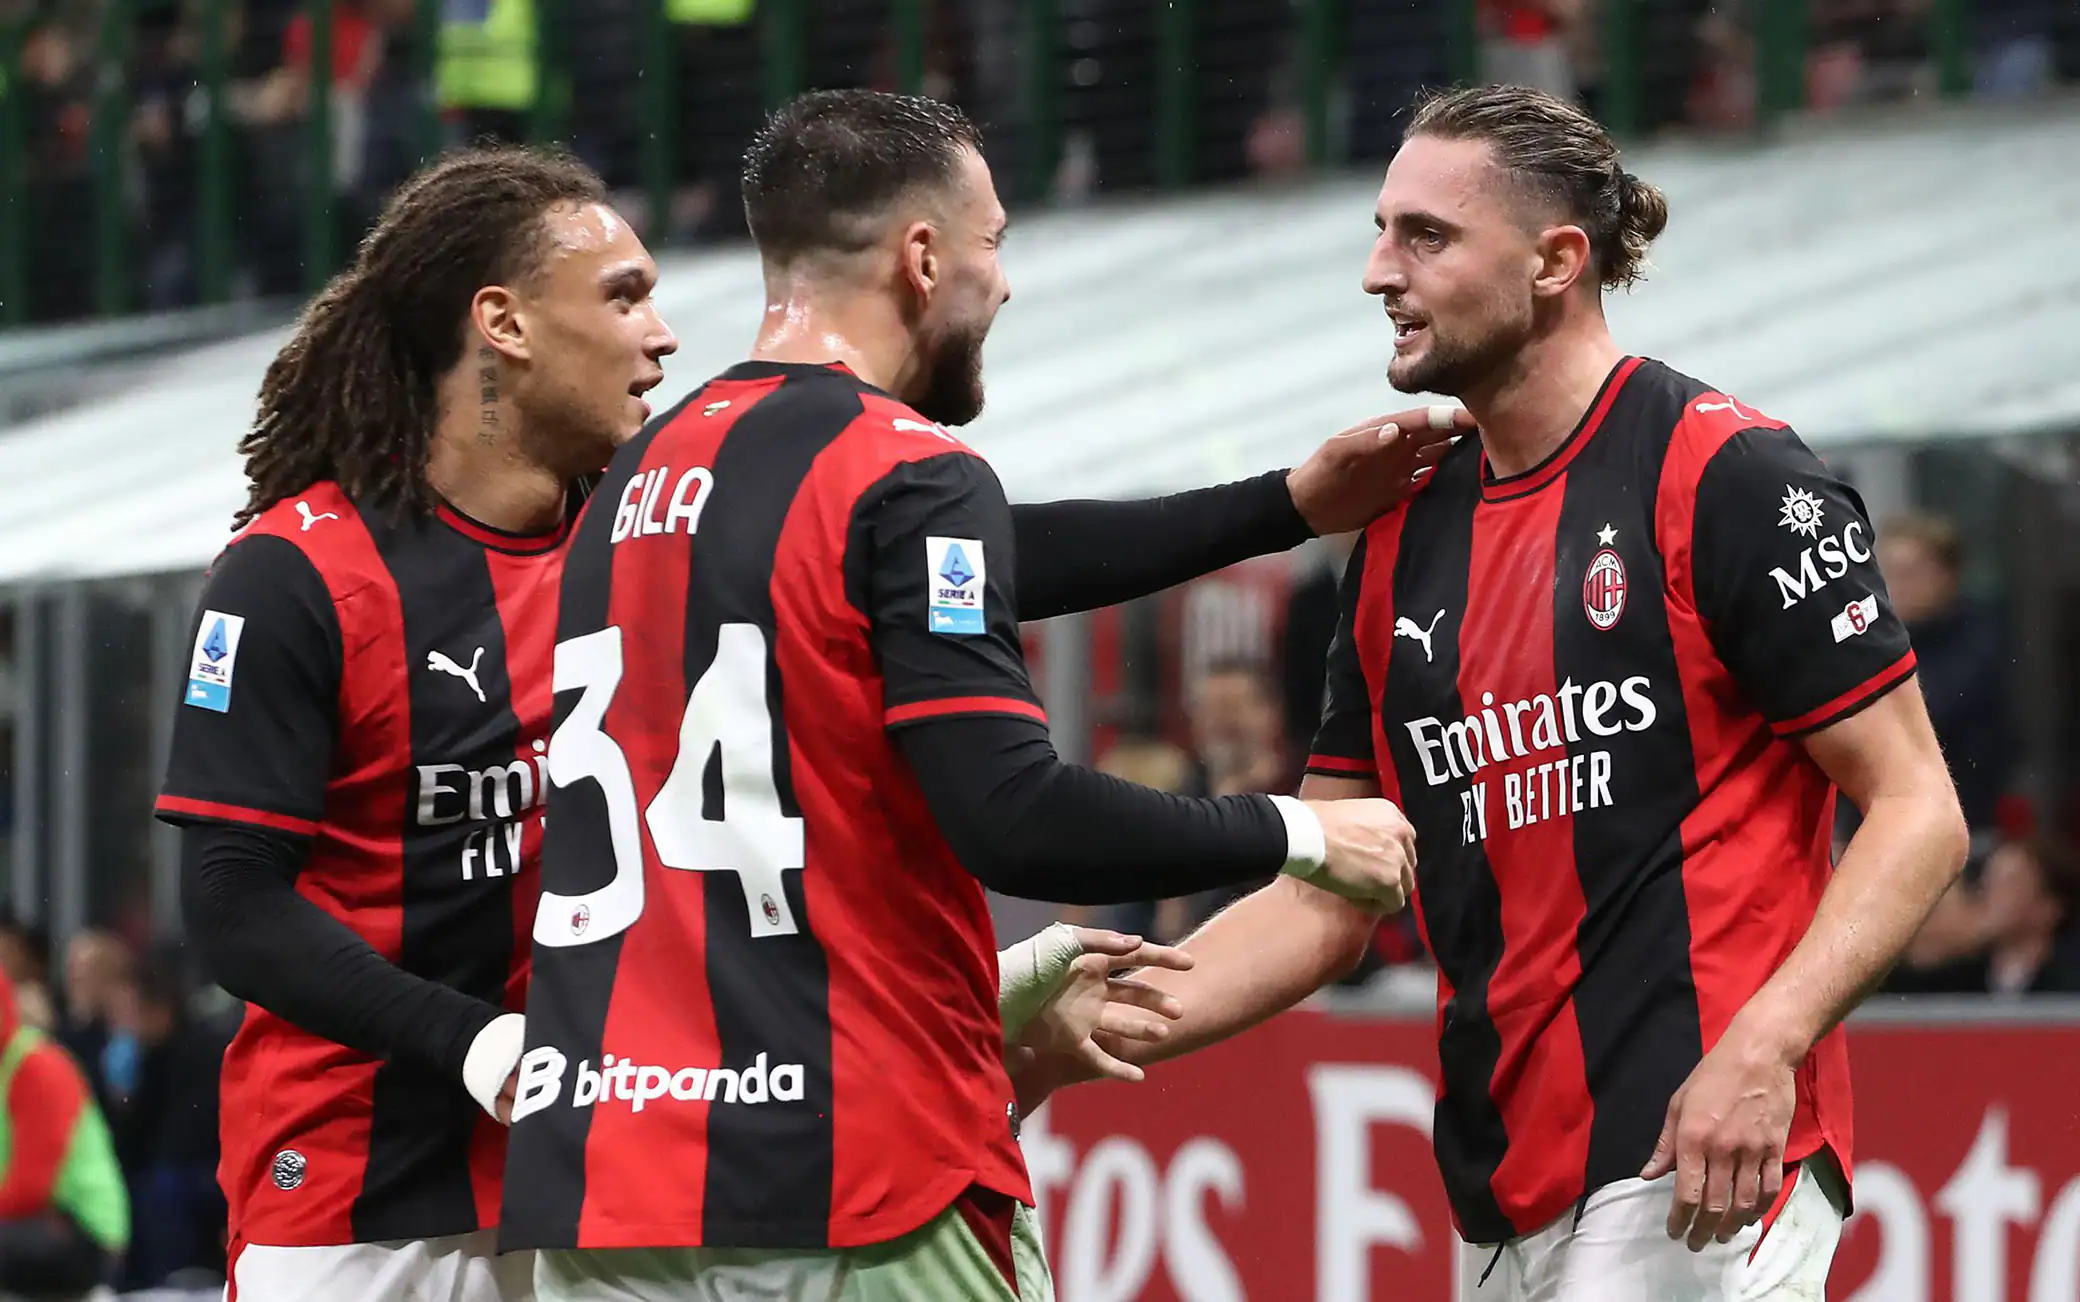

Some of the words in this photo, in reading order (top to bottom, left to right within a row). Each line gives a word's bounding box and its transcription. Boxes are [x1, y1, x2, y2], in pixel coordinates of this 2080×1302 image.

[610, 466, 714, 544] GILA
[1594, 556, 1617, 569] ACM
[1768, 520, 1871, 610] MSC
[938, 588, 965, 600] SERIE
[968, 590, 976, 600] A
[1594, 611, 1616, 622] 1899
[1847, 603, 1866, 632] 6
[1404, 675, 1657, 787] Emirates
[532, 623, 804, 947] 34
[1505, 750, 1614, 830] BETTER
[461, 821, 523, 880] FLY
[572, 1051, 805, 1113] bitpanda
